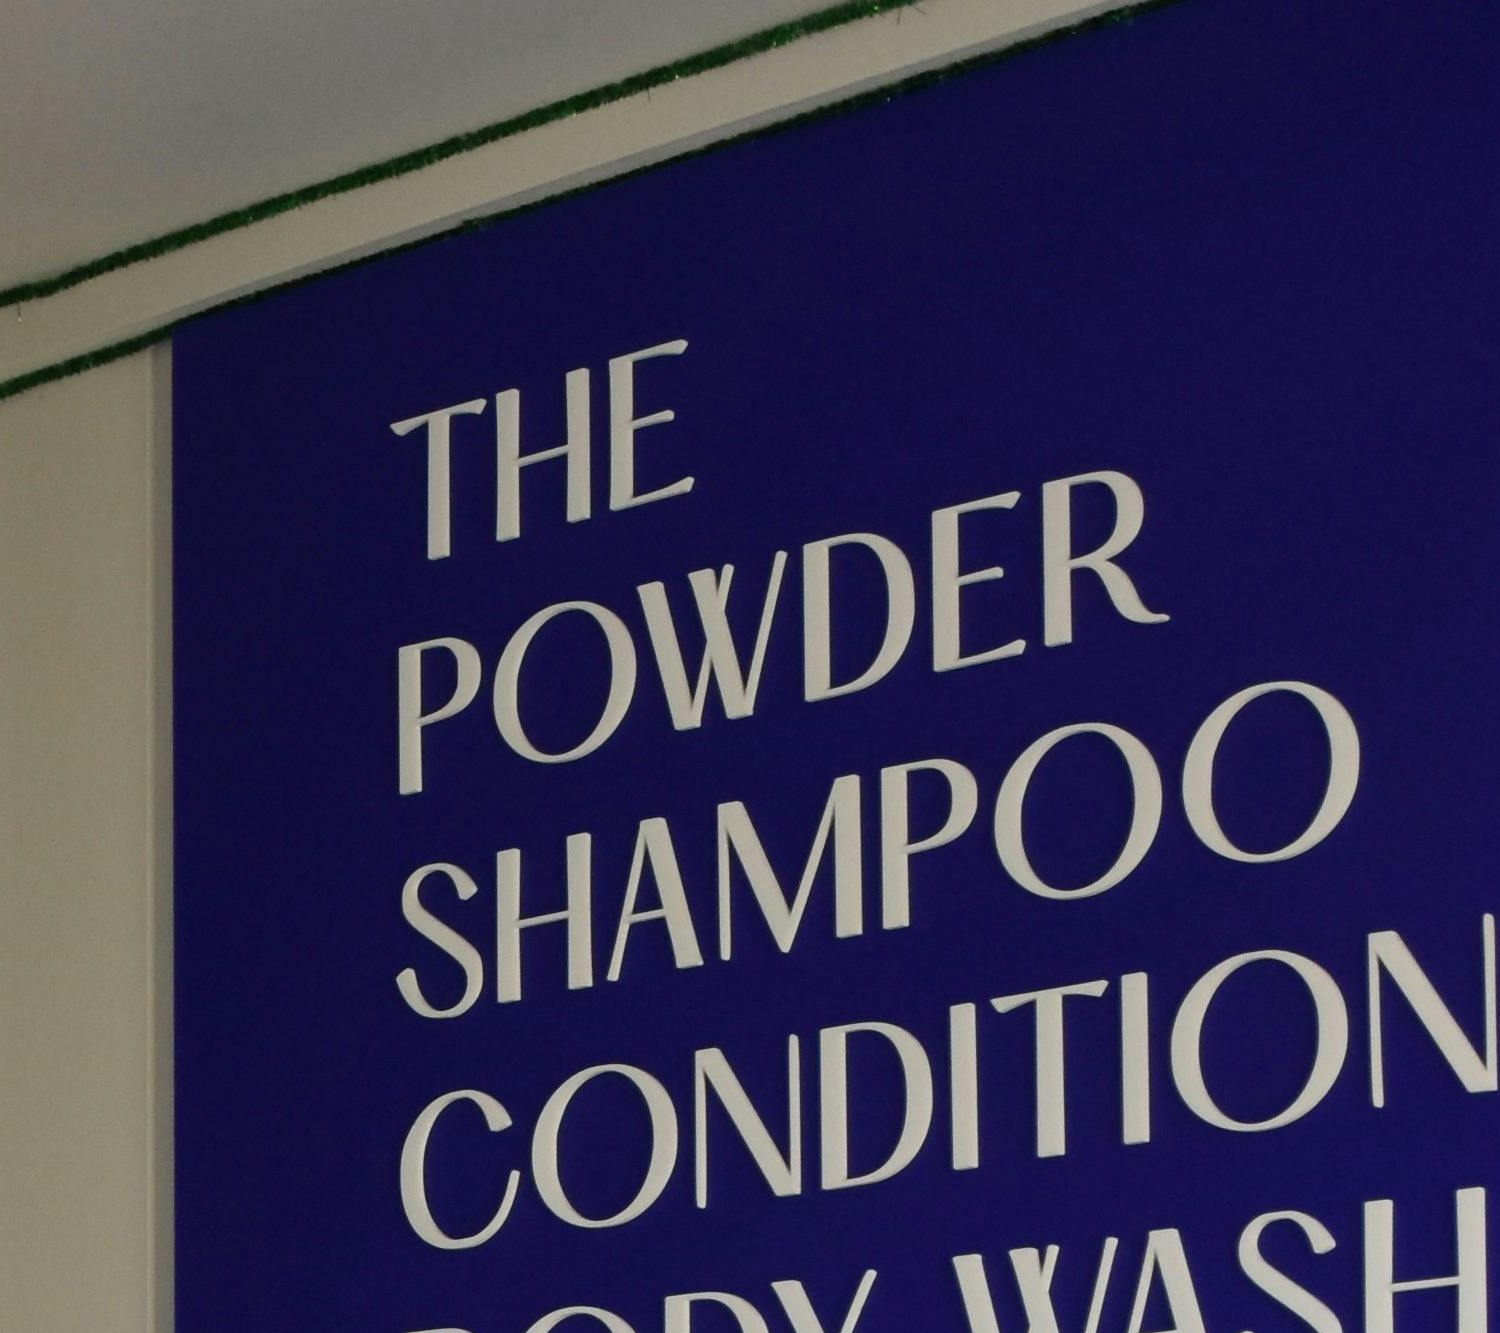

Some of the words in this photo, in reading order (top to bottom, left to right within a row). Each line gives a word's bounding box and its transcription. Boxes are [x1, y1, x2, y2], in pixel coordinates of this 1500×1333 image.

[390, 339, 695, 559] THE
[396, 470, 1169, 795] POWDER
[395, 680, 1361, 1020] SHAMPOO
